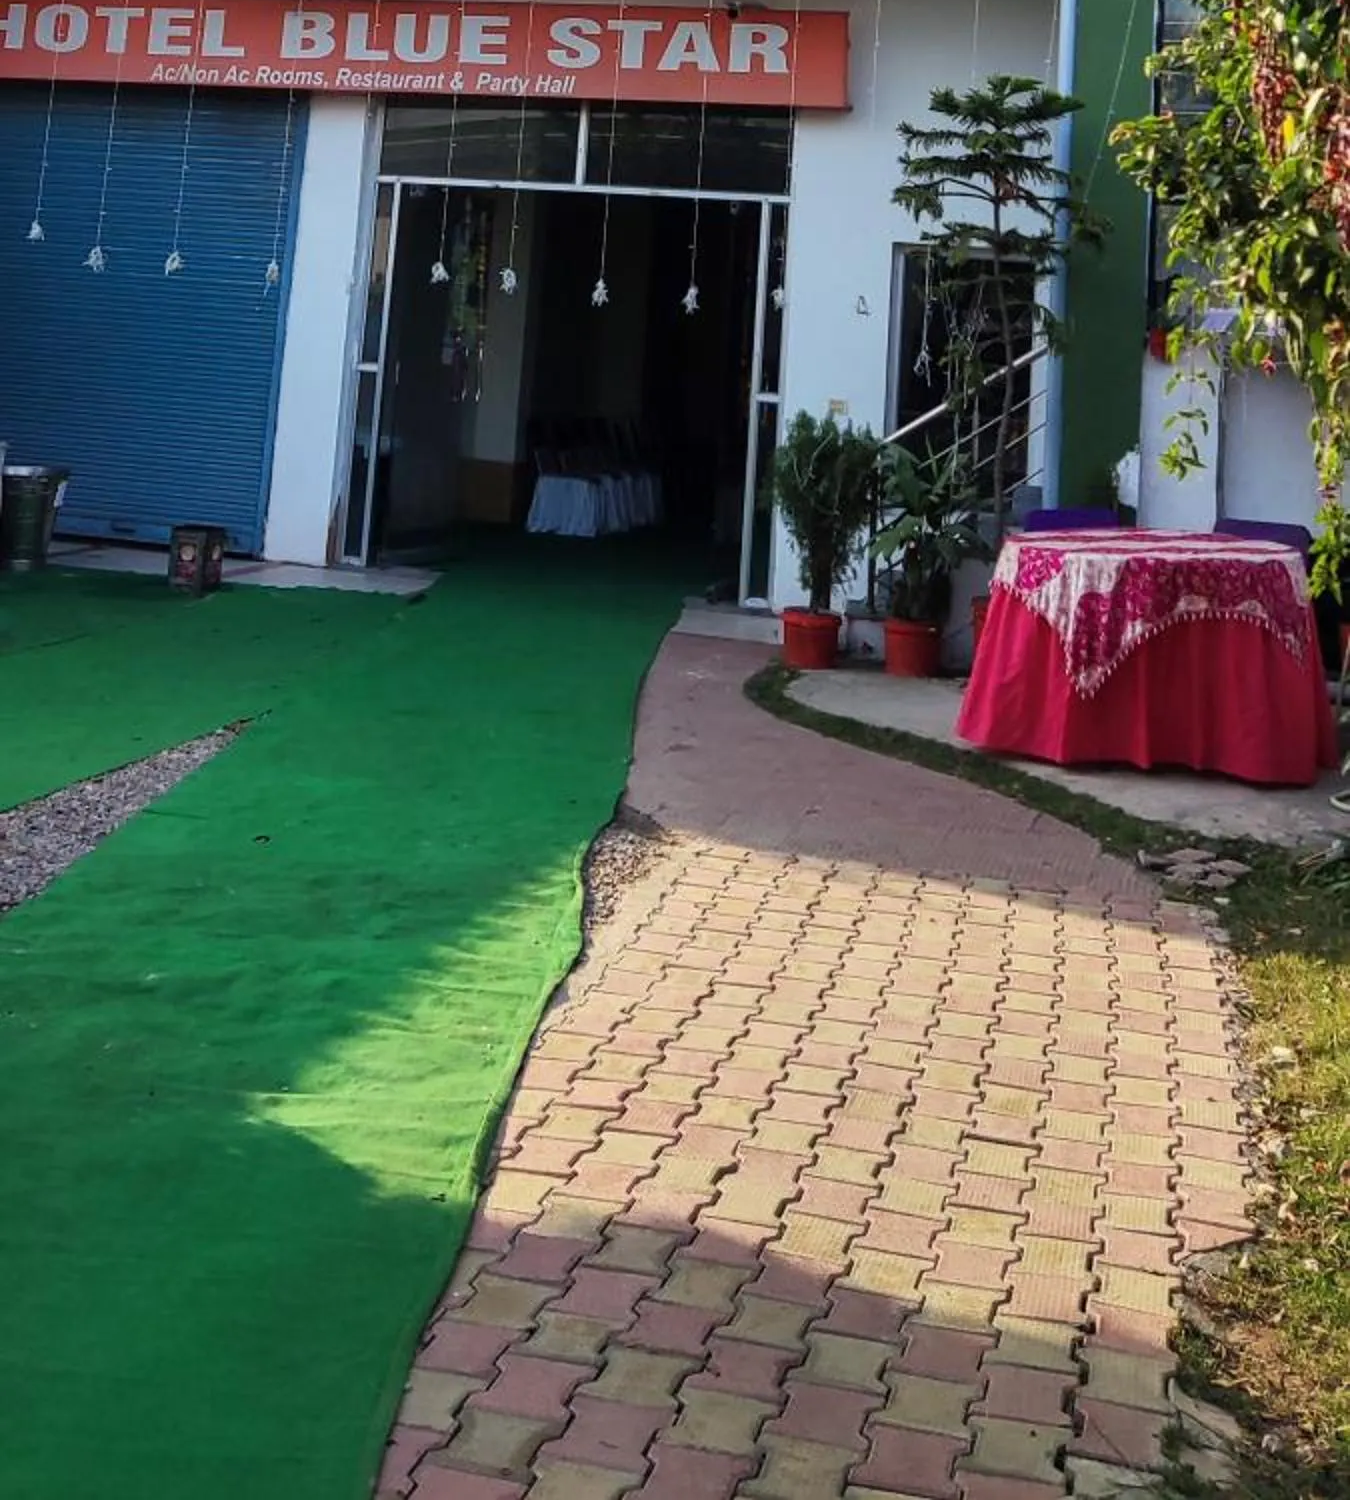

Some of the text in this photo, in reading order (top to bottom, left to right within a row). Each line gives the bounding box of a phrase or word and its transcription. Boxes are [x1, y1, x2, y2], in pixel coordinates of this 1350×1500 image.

[280, 11, 511, 65] BLUE
[547, 18, 790, 74] STAR
[151, 63, 576, 94] Ac/Non Ac Rooms, Restaurant & Party Hall
